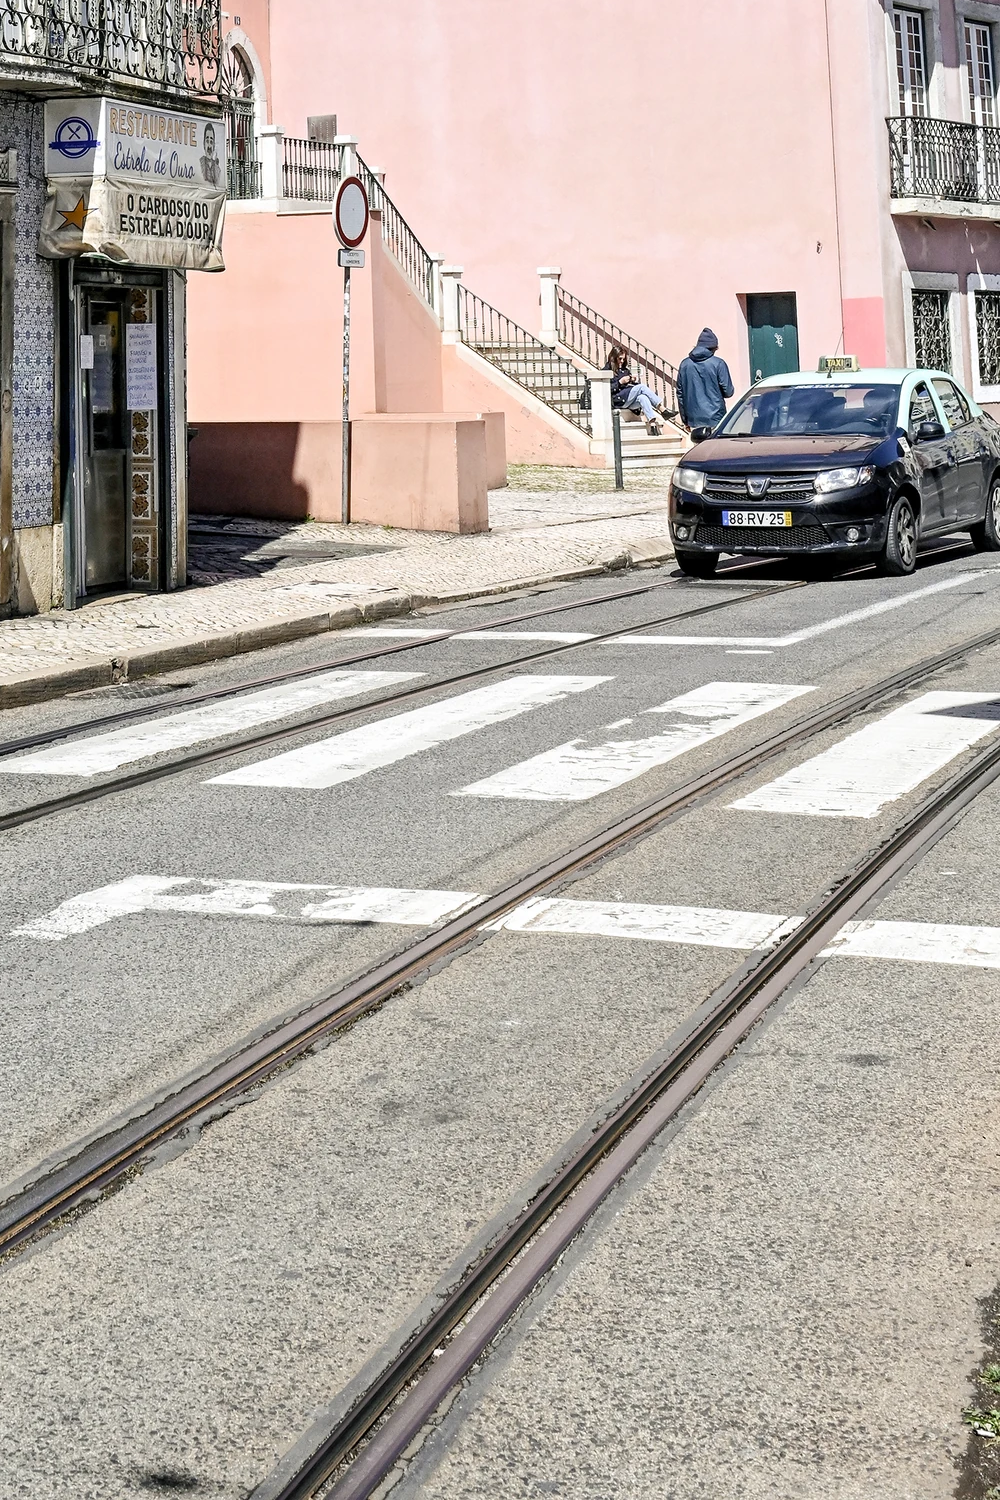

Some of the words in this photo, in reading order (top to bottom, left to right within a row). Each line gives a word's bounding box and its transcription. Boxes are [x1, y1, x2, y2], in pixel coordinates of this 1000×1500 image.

[109, 108, 198, 147] RESTAURANTE
[114, 141, 151, 172] Estrela
[154, 149, 167, 174] de
[169, 151, 195, 179] Ouro
[127, 194, 135, 212] O
[139, 195, 191, 219] CARDOSO
[194, 202, 209, 220] DO
[120, 214, 173, 238] ESTRELA
[826, 358, 844, 367] TAXI
